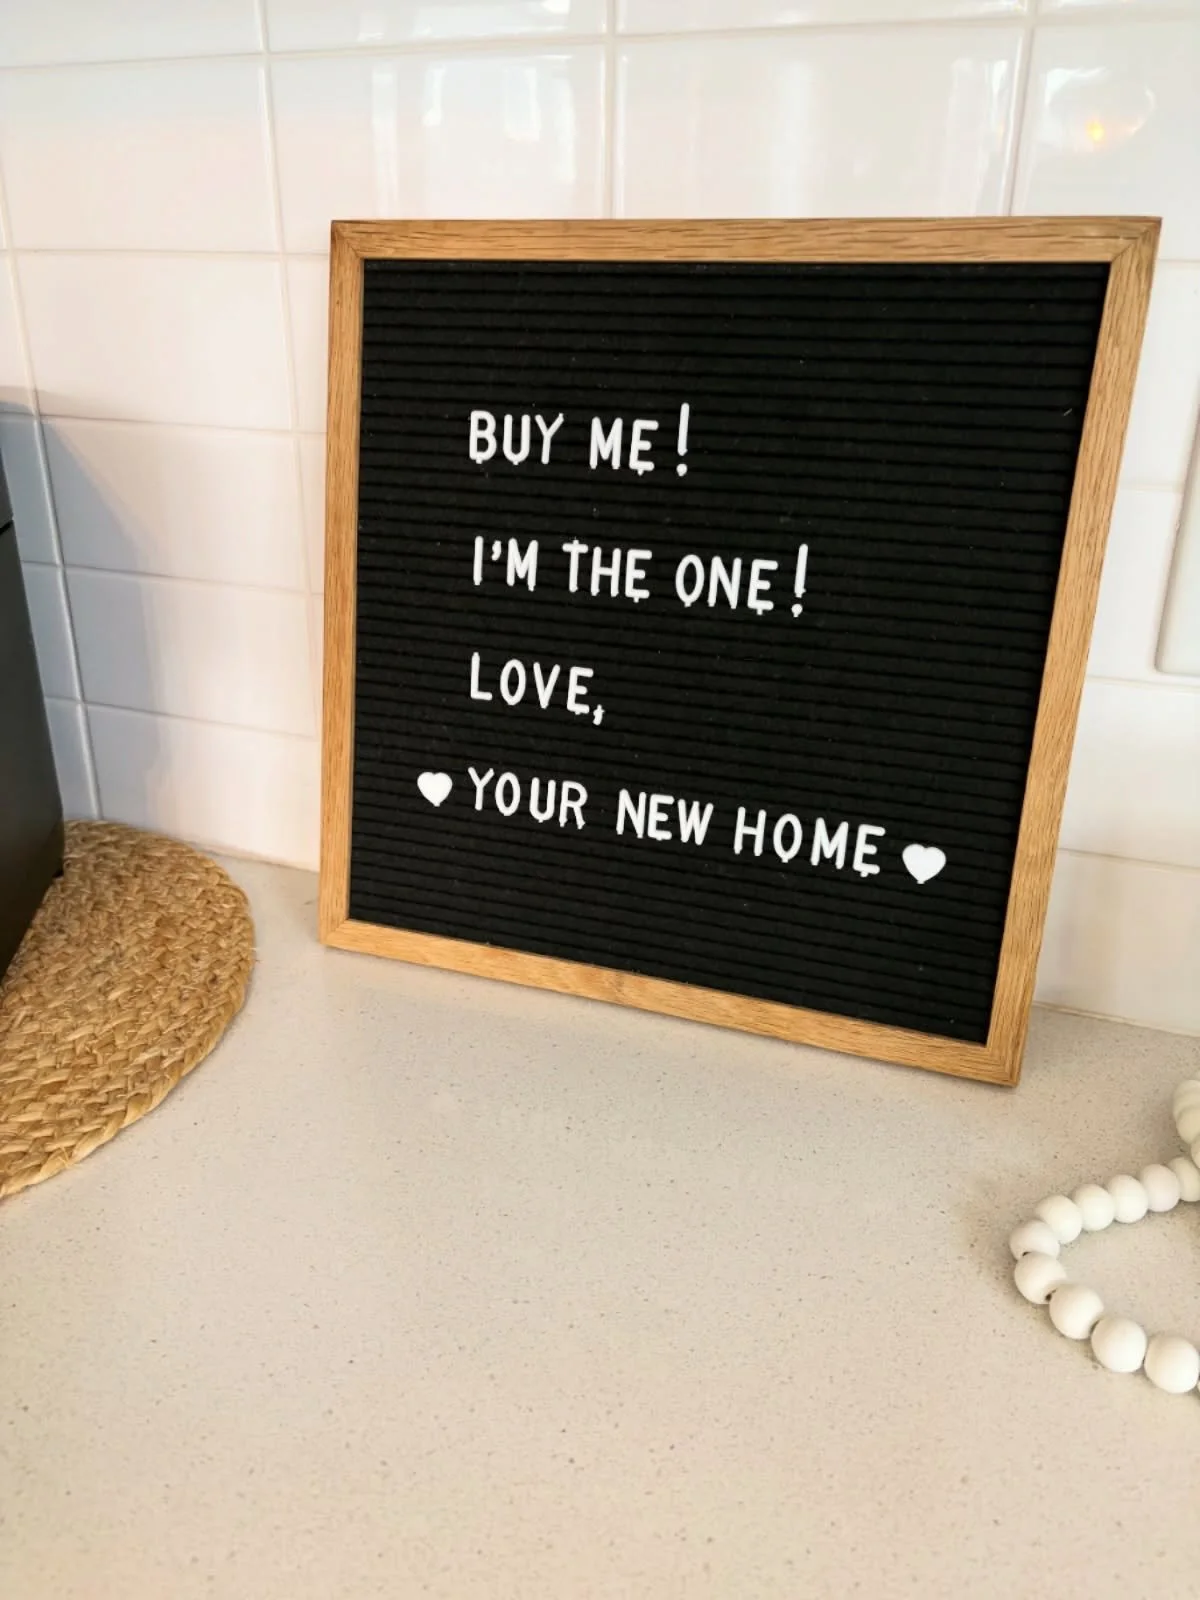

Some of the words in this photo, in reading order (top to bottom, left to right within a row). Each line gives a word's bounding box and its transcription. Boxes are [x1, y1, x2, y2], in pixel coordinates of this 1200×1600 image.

[469, 410, 565, 466] BUY
[473, 535, 539, 592] I'M
[561, 539, 653, 603] THE
[470, 651, 605, 726] LOVE,
[467, 766, 588, 830] YOUR
[615, 788, 714, 846] NEW
[733, 806, 886, 878] HOME
